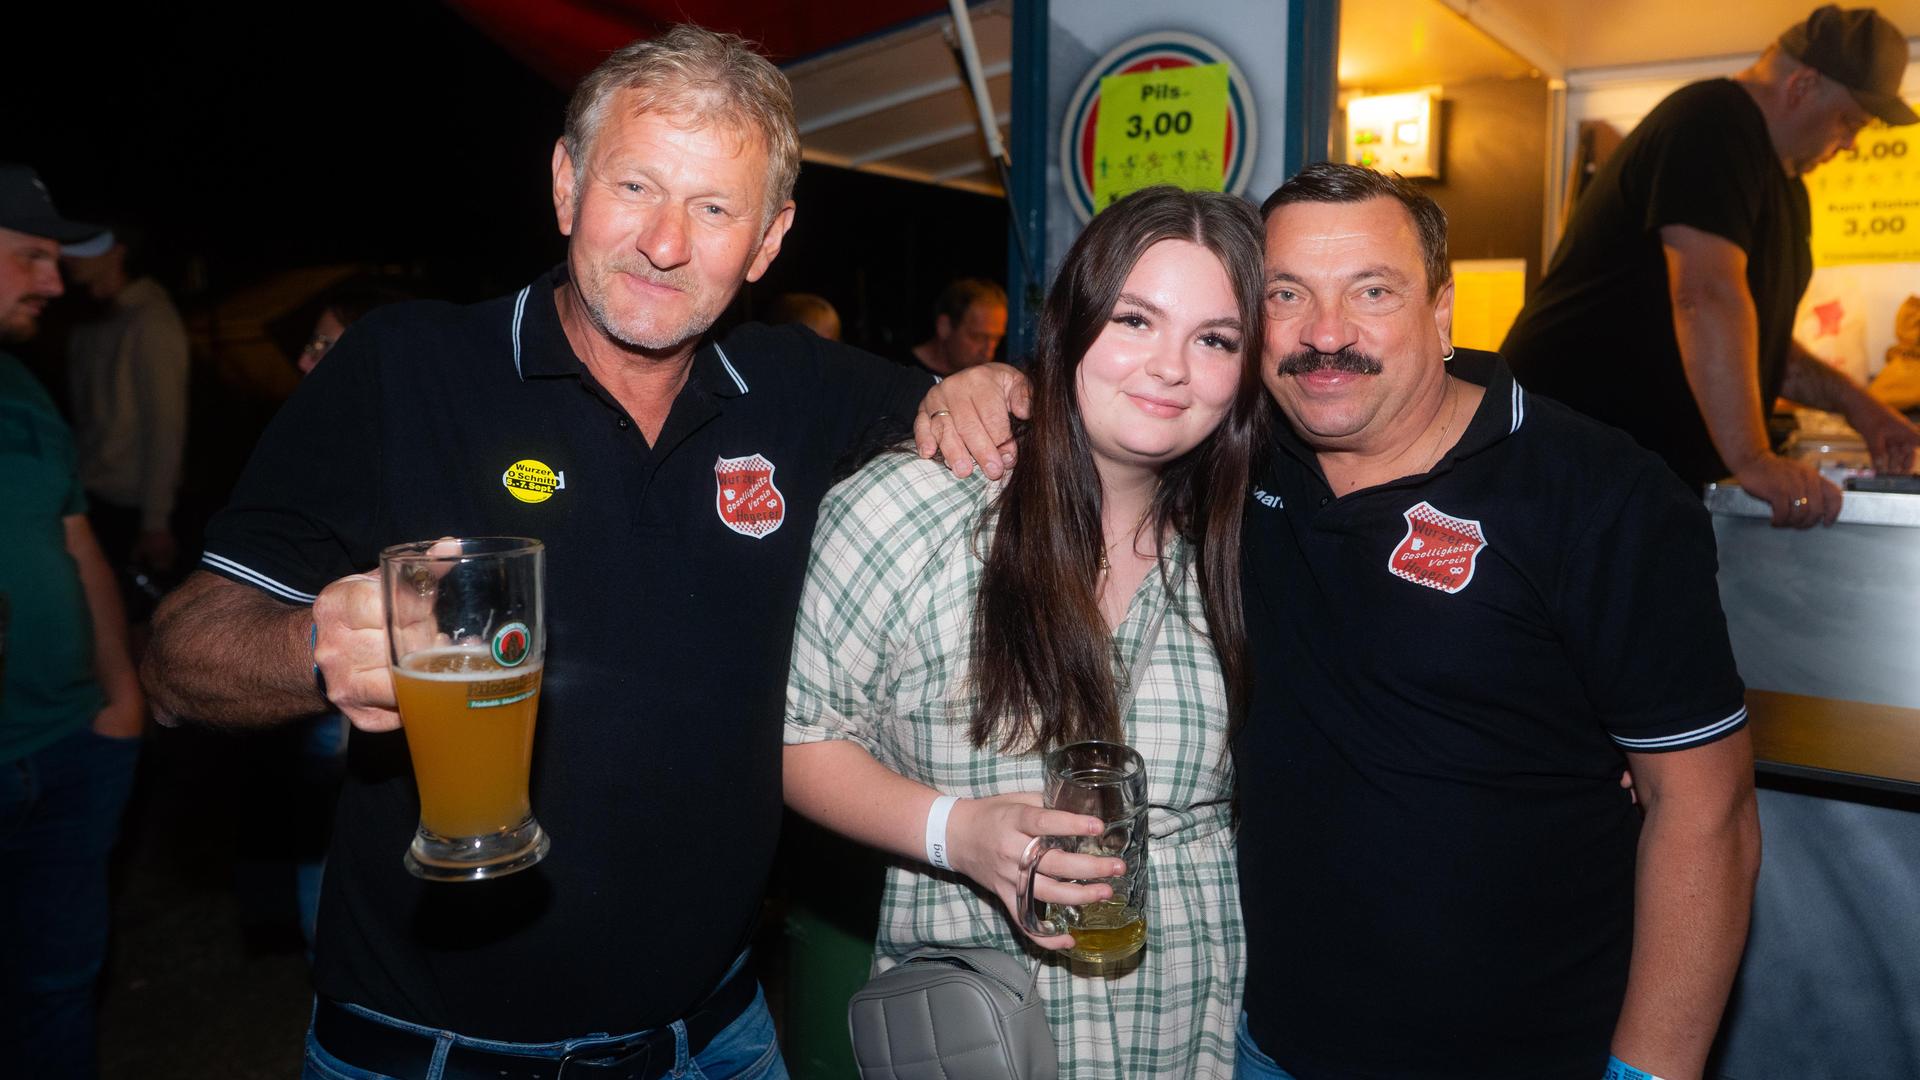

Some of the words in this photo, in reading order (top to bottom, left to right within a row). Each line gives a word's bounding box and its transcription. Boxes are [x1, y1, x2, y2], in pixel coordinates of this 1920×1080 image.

[1126, 111, 1193, 142] 3,00
[1844, 216, 1906, 238] 3,00
[516, 464, 552, 476] Wurzer
[518, 473, 555, 485] Schnitt
[747, 489, 772, 511] Verein
[1414, 520, 1462, 545] Wurzer
[1402, 543, 1475, 560] Geselligkeits
[1427, 555, 1467, 568] Verein
